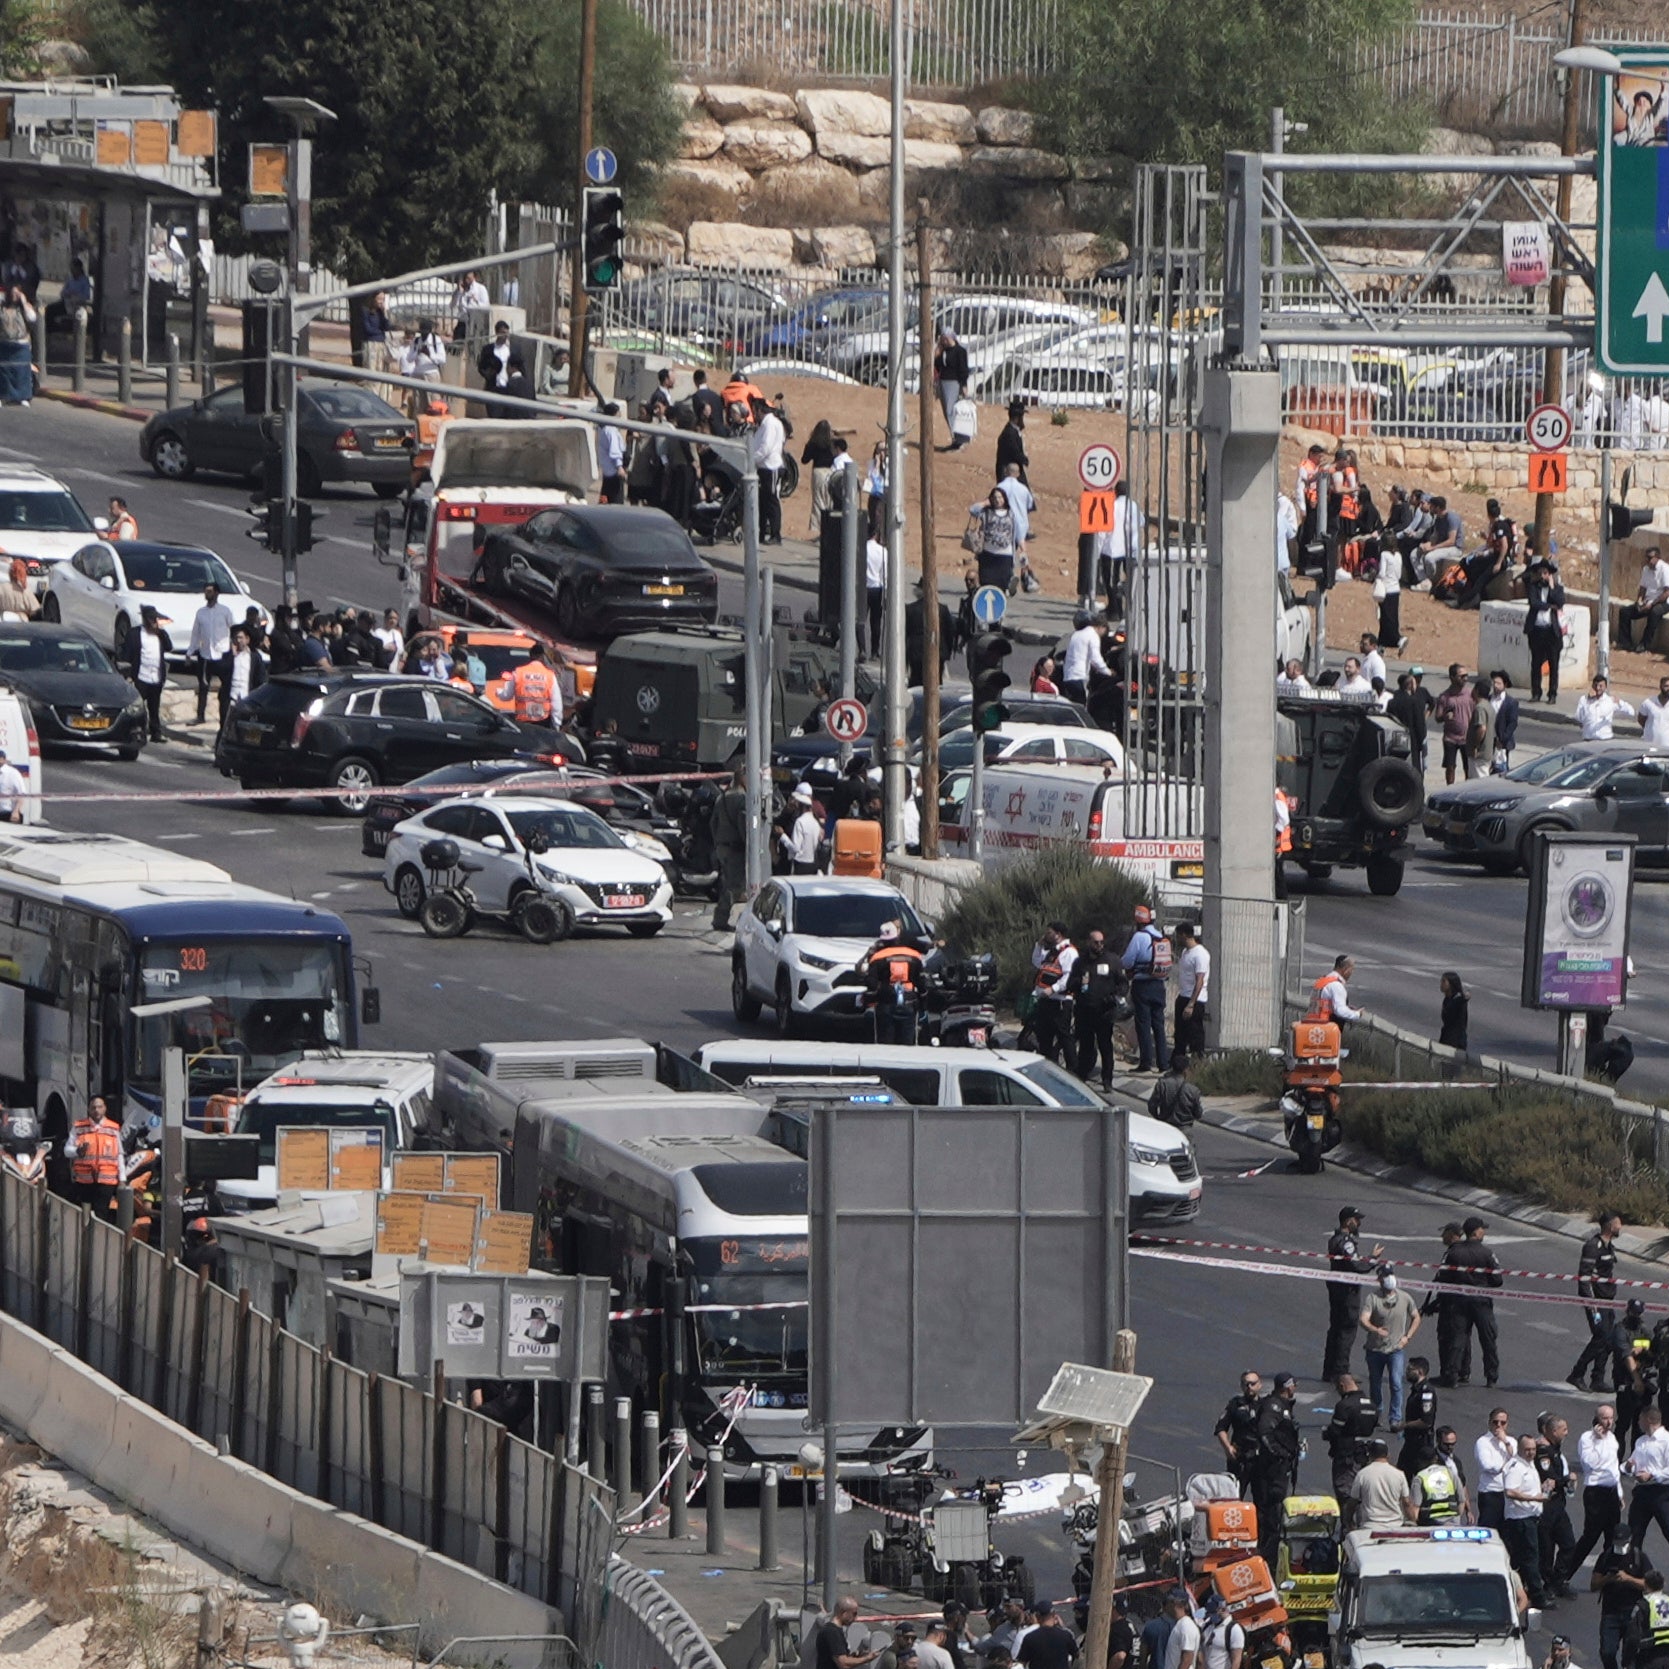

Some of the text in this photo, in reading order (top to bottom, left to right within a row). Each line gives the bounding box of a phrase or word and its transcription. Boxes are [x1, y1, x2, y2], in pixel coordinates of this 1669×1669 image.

[1536, 417, 1563, 438] 50
[1087, 457, 1112, 477] 50
[1124, 843, 1204, 857] AMBULANC
[180, 948, 206, 970] 320
[721, 1241, 739, 1264] 62
